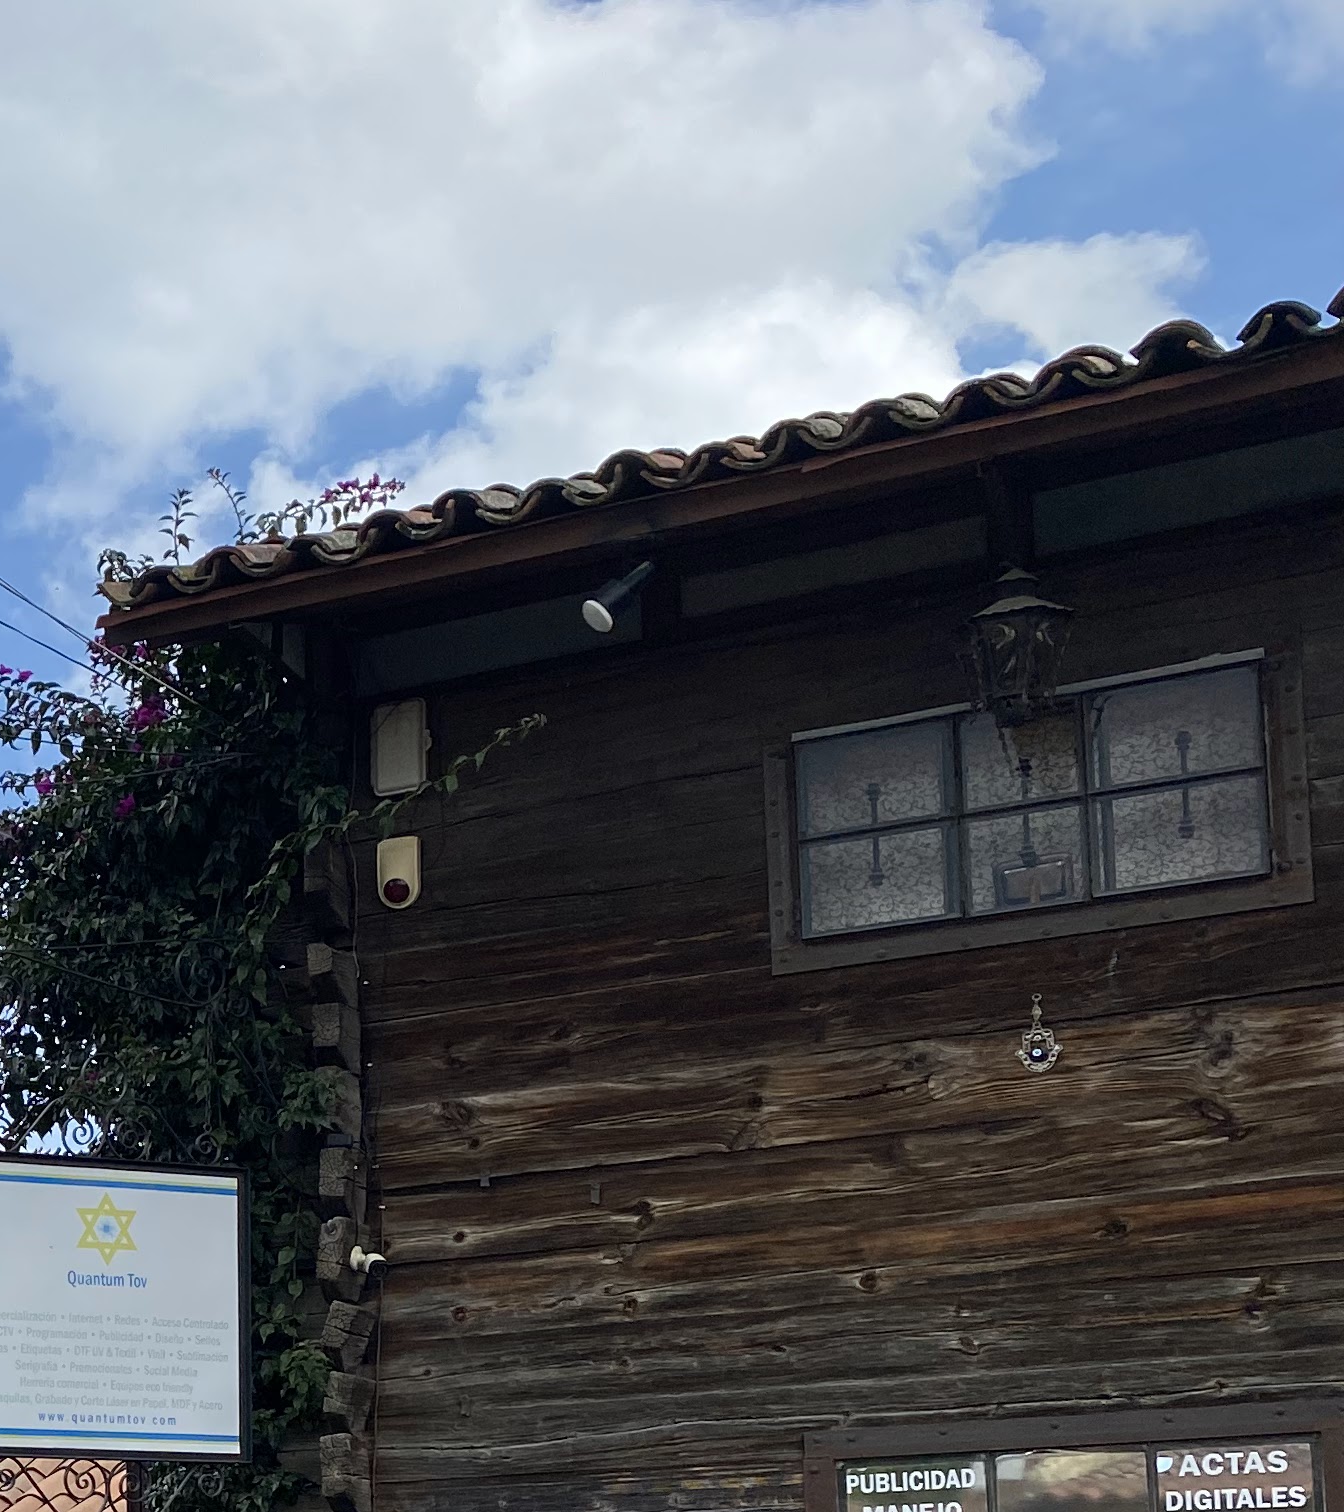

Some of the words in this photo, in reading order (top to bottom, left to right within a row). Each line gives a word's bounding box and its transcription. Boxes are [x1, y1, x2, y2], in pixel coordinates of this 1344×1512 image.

[67, 1270, 125, 1288] Quantum
[127, 1272, 148, 1288] Tov
[69, 1312, 104, 1324] Internet
[115, 1314, 141, 1326] Redes
[152, 1316, 182, 1327] Acceso
[183, 1318, 229, 1330] Controlado
[99, 1330, 144, 1342] Publicidad
[20, 1343, 62, 1356] Etiquetas
[74, 1345, 91, 1356] DTF
[92, 1346, 104, 1357] UV
[144, 1365, 169, 1376] Social
[171, 1366, 198, 1378] Media
[57, 1379, 99, 1389] comercial
[110, 1380, 144, 1393] Equipos
[145, 1383, 160, 1392] eco
[34, 1393, 72, 1405] Grabado
[73, 1398, 79, 1409] y
[81, 1395, 105, 1406] Corte
[1178, 1450, 1288, 1476] ACTAS
[846, 1468, 977, 1495] PUBLICIDAD
[1165, 1486, 1306, 1512] DIGITALES
